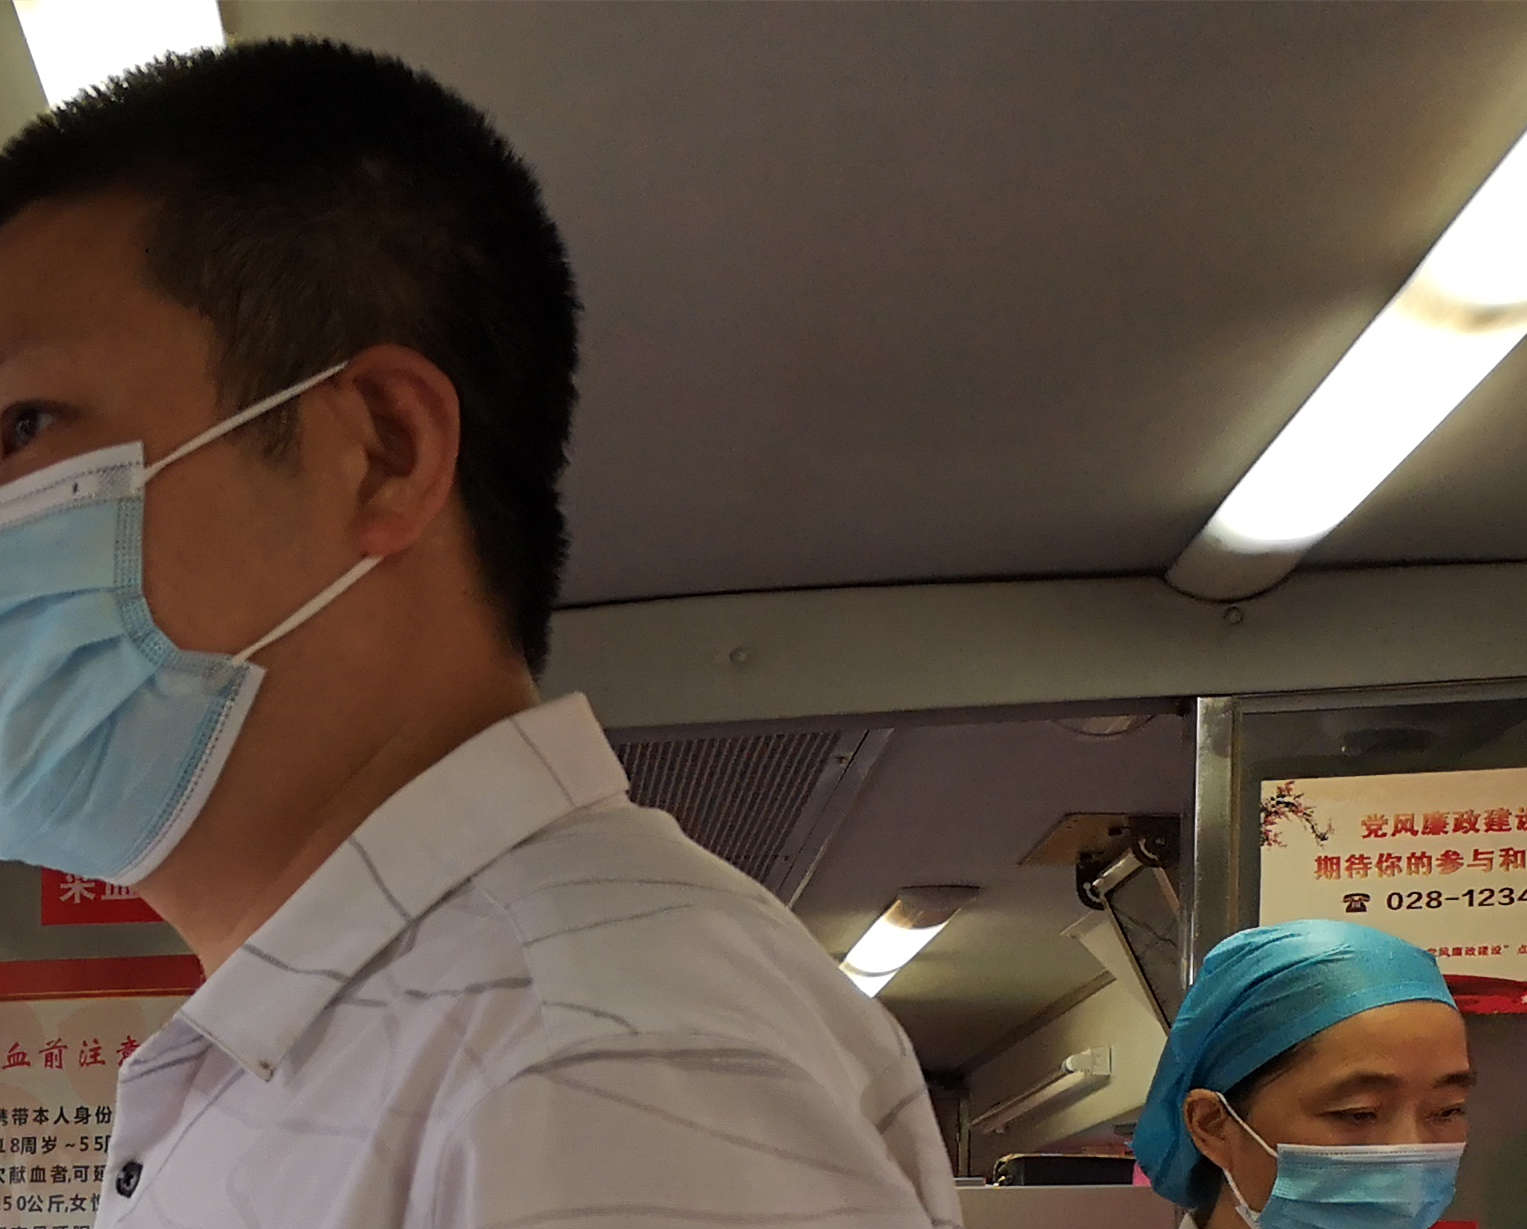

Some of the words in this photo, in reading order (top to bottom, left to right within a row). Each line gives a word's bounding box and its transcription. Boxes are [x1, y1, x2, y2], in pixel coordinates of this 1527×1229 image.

[1314, 847, 1527, 880] 期待你的参与和
